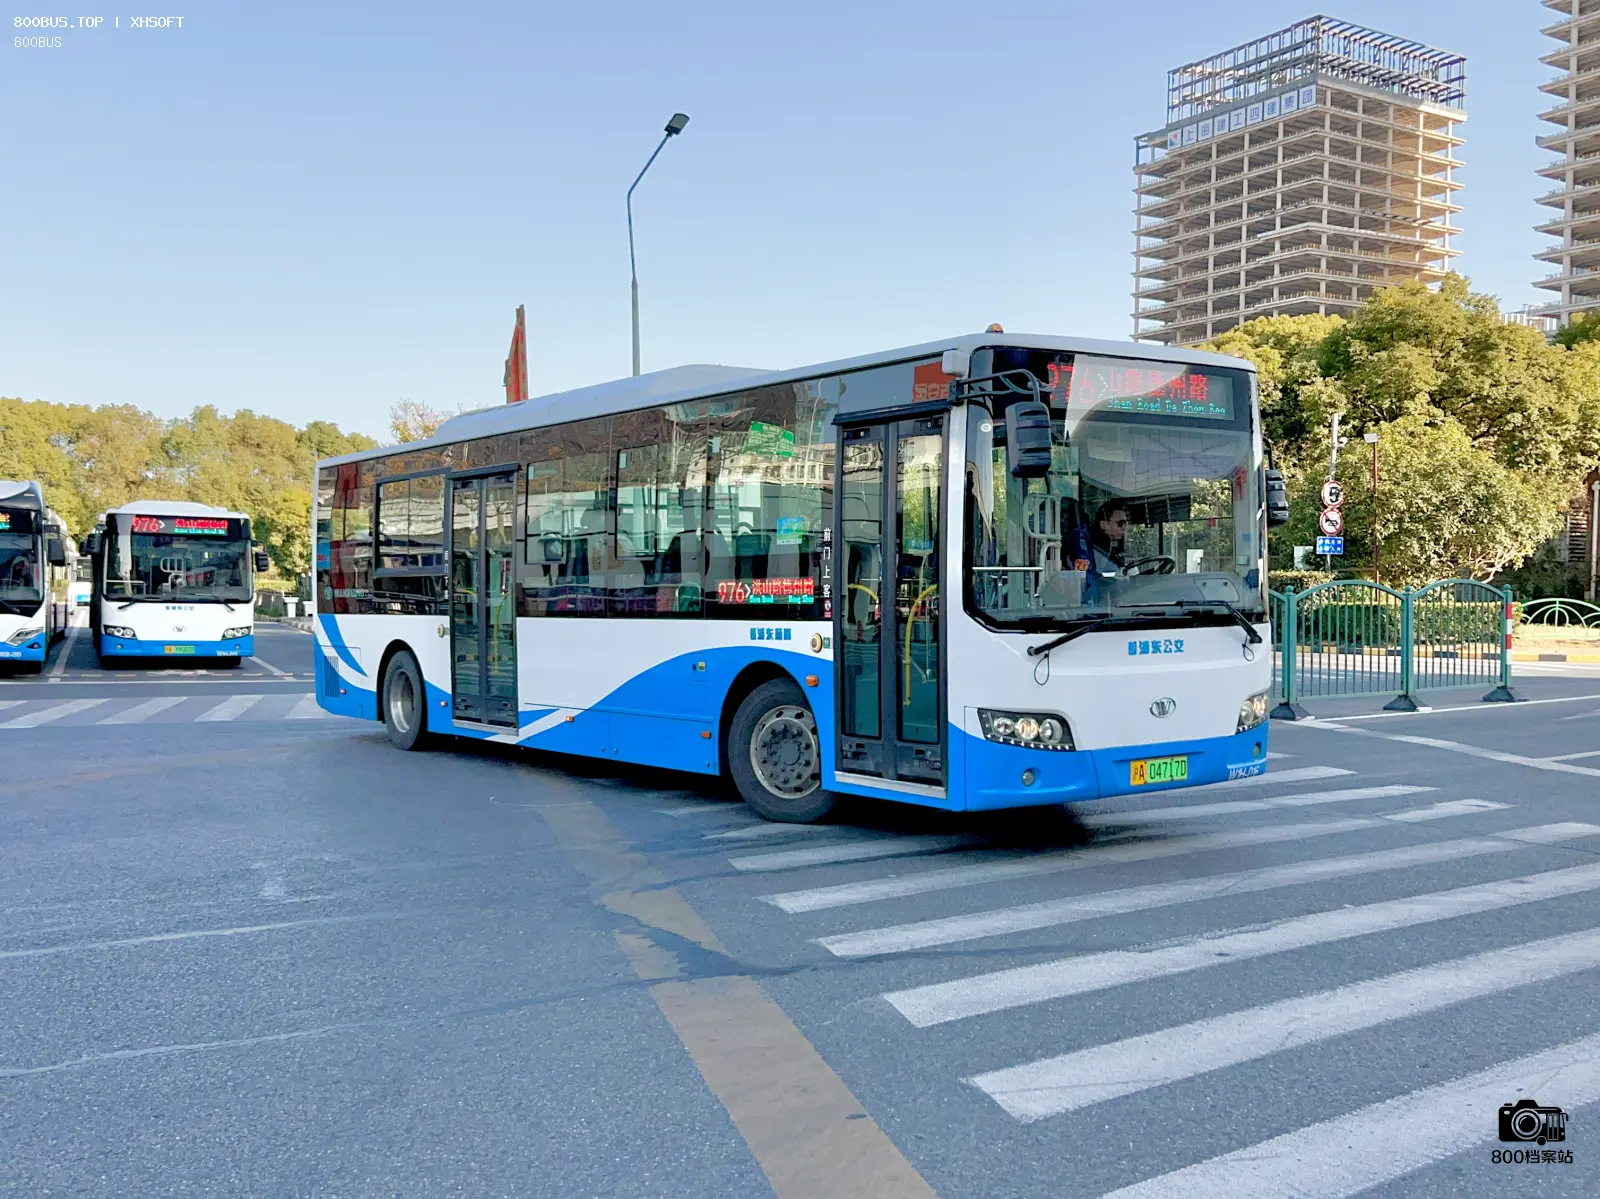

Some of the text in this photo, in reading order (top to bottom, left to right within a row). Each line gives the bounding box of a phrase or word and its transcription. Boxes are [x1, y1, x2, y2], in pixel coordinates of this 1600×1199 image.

[1186, 88, 1313, 142] 上海建工四建集团
[717, 581, 746, 604] 976
